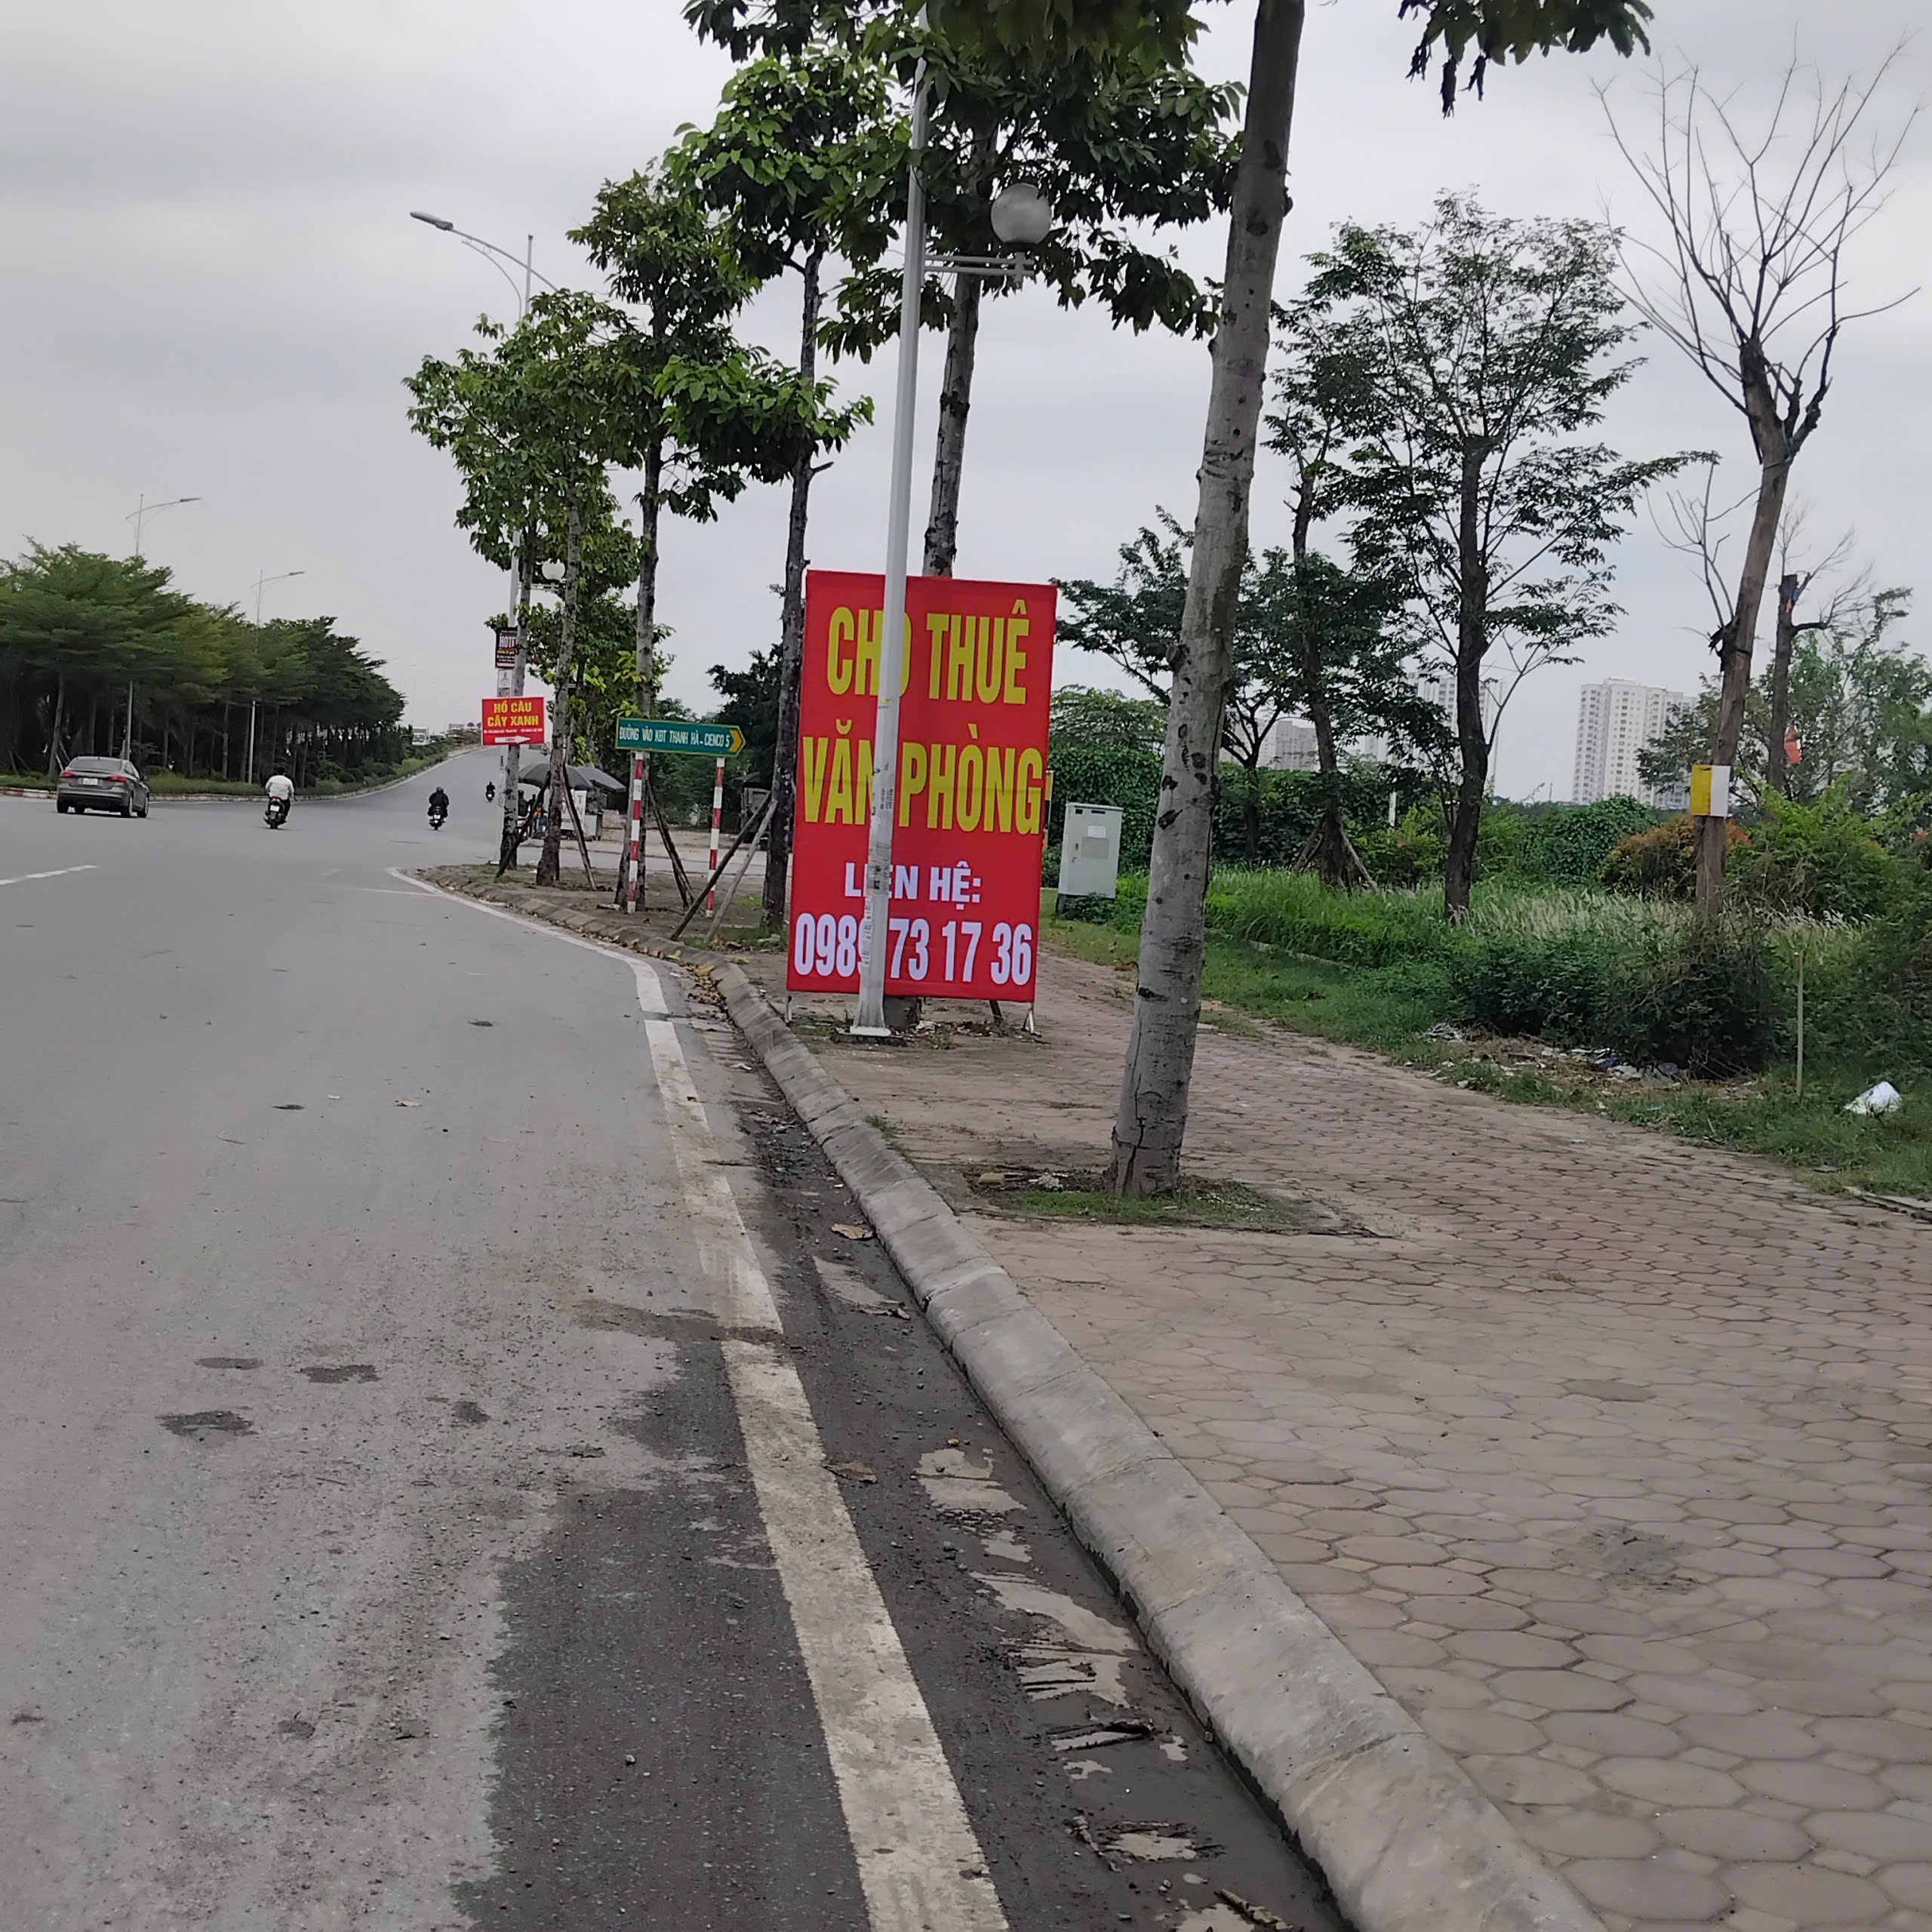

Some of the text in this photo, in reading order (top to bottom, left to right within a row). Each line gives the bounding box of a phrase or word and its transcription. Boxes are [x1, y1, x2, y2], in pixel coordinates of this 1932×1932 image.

[927, 598, 1030, 705] THUÊ
[488, 714, 539, 727] CÂY XANH
[642, 725, 653, 742] VÀO
[669, 730, 688, 745] THANH
[691, 729, 699, 746] HÀ
[704, 733, 724, 748] CIENCO
[725, 734, 731, 748] 5
[802, 718, 1043, 835] VĂN PHÒNG
[930, 861, 981, 910] HỆ:
[889, 918, 930, 980] 73
[942, 921, 982, 983] 17
[990, 922, 1032, 986] 36
